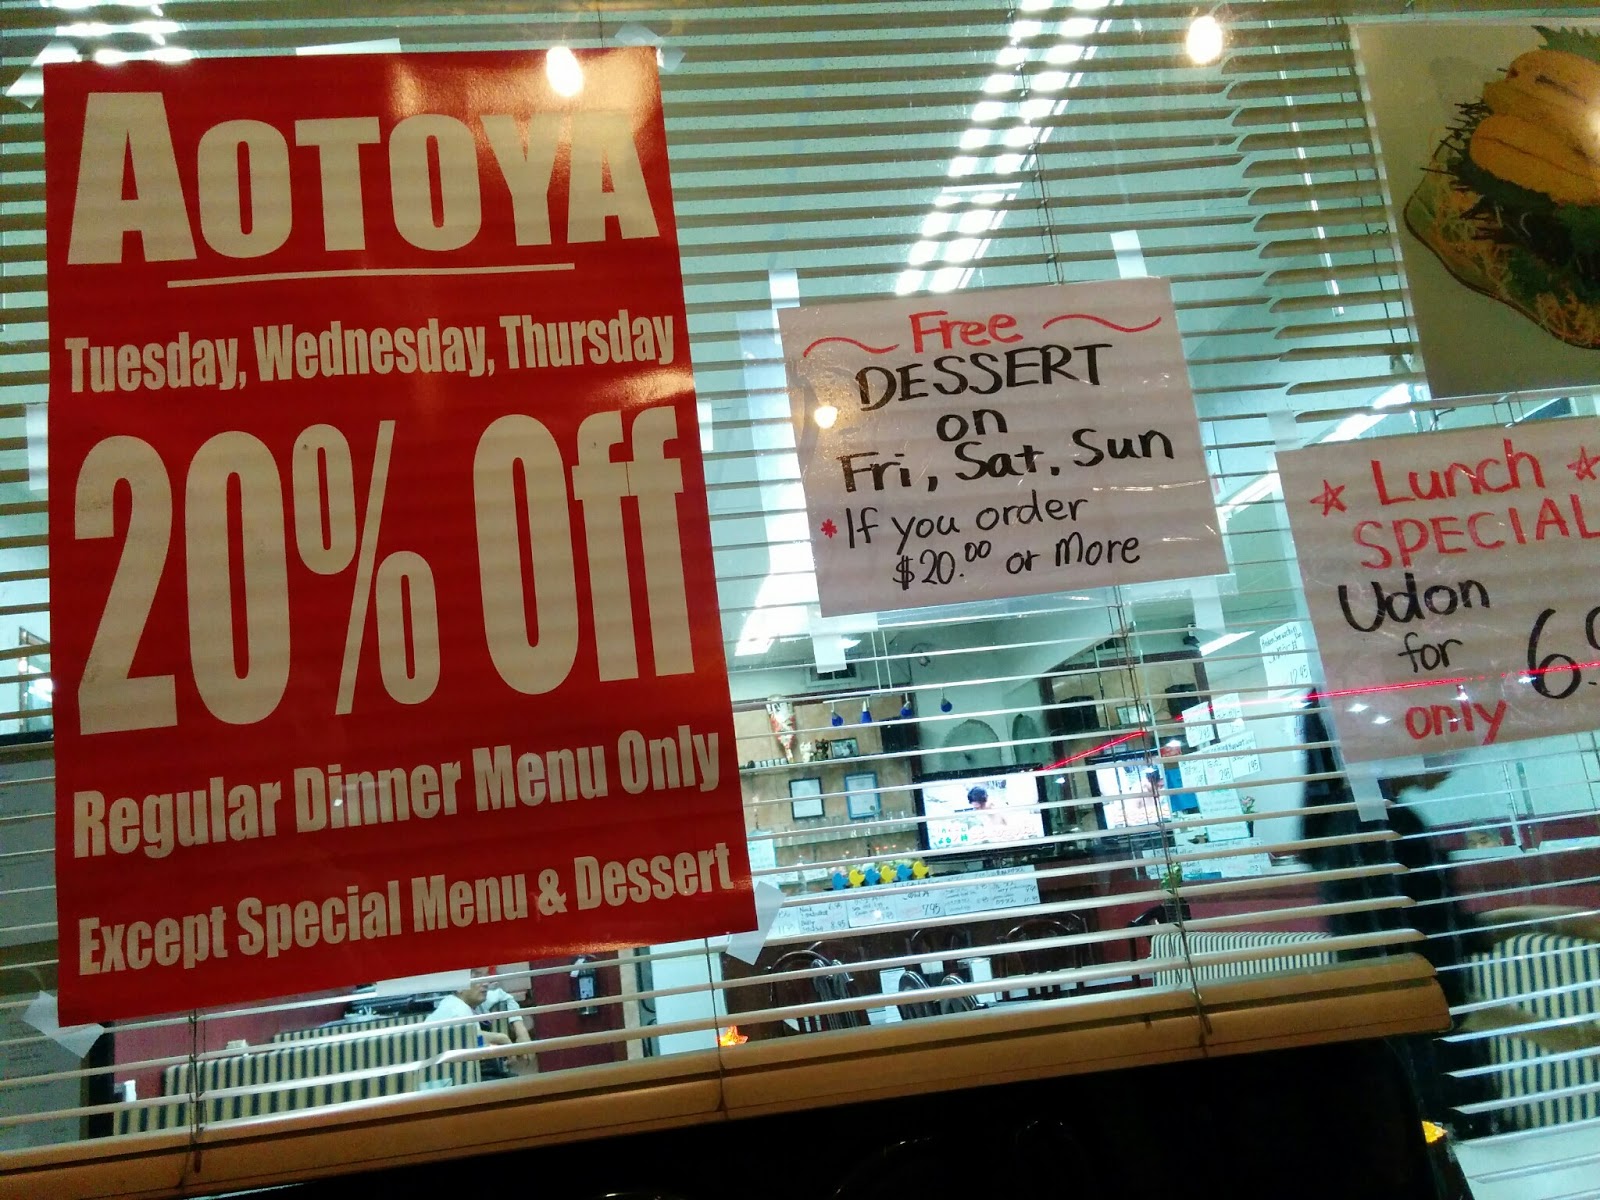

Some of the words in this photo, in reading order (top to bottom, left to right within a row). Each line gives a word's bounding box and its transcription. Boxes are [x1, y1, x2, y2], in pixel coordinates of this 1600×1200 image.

[67, 92, 660, 265] AOTOYA
[65, 331, 247, 392] Tuesday,
[253, 315, 496, 381] Wednesday,
[500, 309, 676, 372] Thursday
[909, 310, 1024, 354] Free
[855, 344, 1113, 411] DESSERT
[937, 408, 1008, 442] on
[836, 451, 938, 493] Fri,
[954, 441, 1061, 481] Sat.
[1072, 428, 1174, 467] Sun
[1371, 438, 1545, 506] Lunch
[845, 507, 879, 549] If
[891, 515, 960, 556] you
[976, 490, 1089, 532] order
[1353, 494, 1600, 569] SPECIAL
[75, 420, 441, 735] 20%
[473, 406, 694, 694] Off
[1006, 550, 1041, 575] or
[1338, 572, 1491, 633] Udon
[1398, 632, 1464, 673] for
[1405, 684, 1508, 746] only
[74, 776, 282, 858] Regular
[294, 761, 461, 833] Dinner
[473, 745, 608, 811] Menu
[617, 725, 721, 793] Only
[78, 904, 228, 975] Except
[238, 880, 401, 957] Special
[412, 874, 528, 931] Menu
[538, 869, 567, 915] &
[574, 842, 735, 910] Dessert
